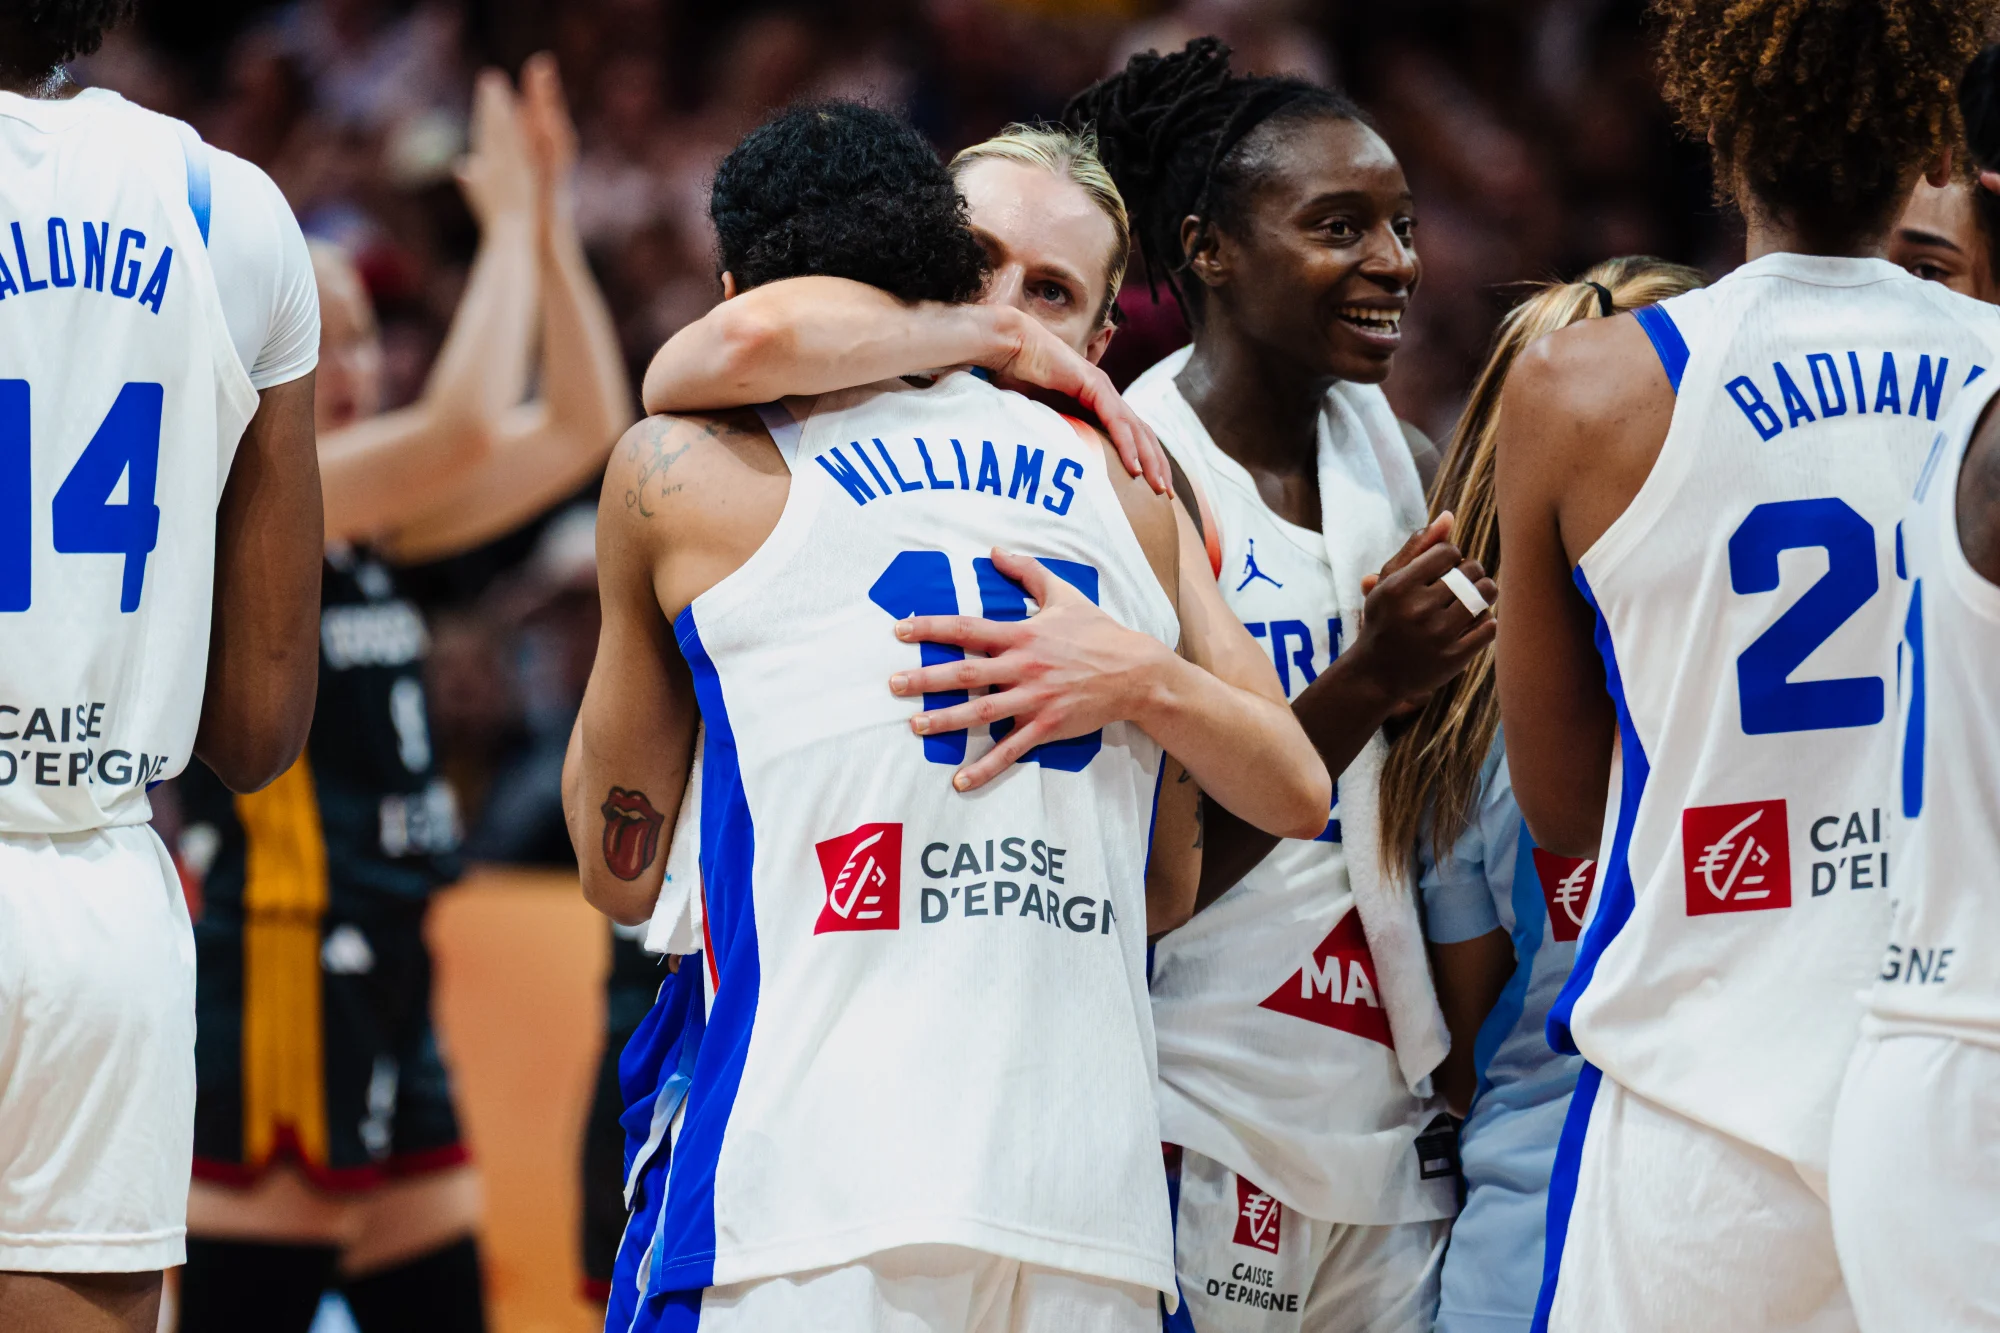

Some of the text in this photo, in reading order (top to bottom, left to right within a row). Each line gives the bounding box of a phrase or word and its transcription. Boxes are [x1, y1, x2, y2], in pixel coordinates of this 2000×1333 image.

[1724, 351, 1986, 442] BADIAN
[814, 437, 1084, 516] WILLIAMS
[1728, 497, 1907, 735] 2
[0, 702, 105, 743] CAISE
[1810, 808, 1891, 852] CAI
[920, 836, 1067, 885] CAISSE
[1206, 1278, 1299, 1313] D'EPARGNE
[1231, 1262, 1274, 1289] CAISSE
